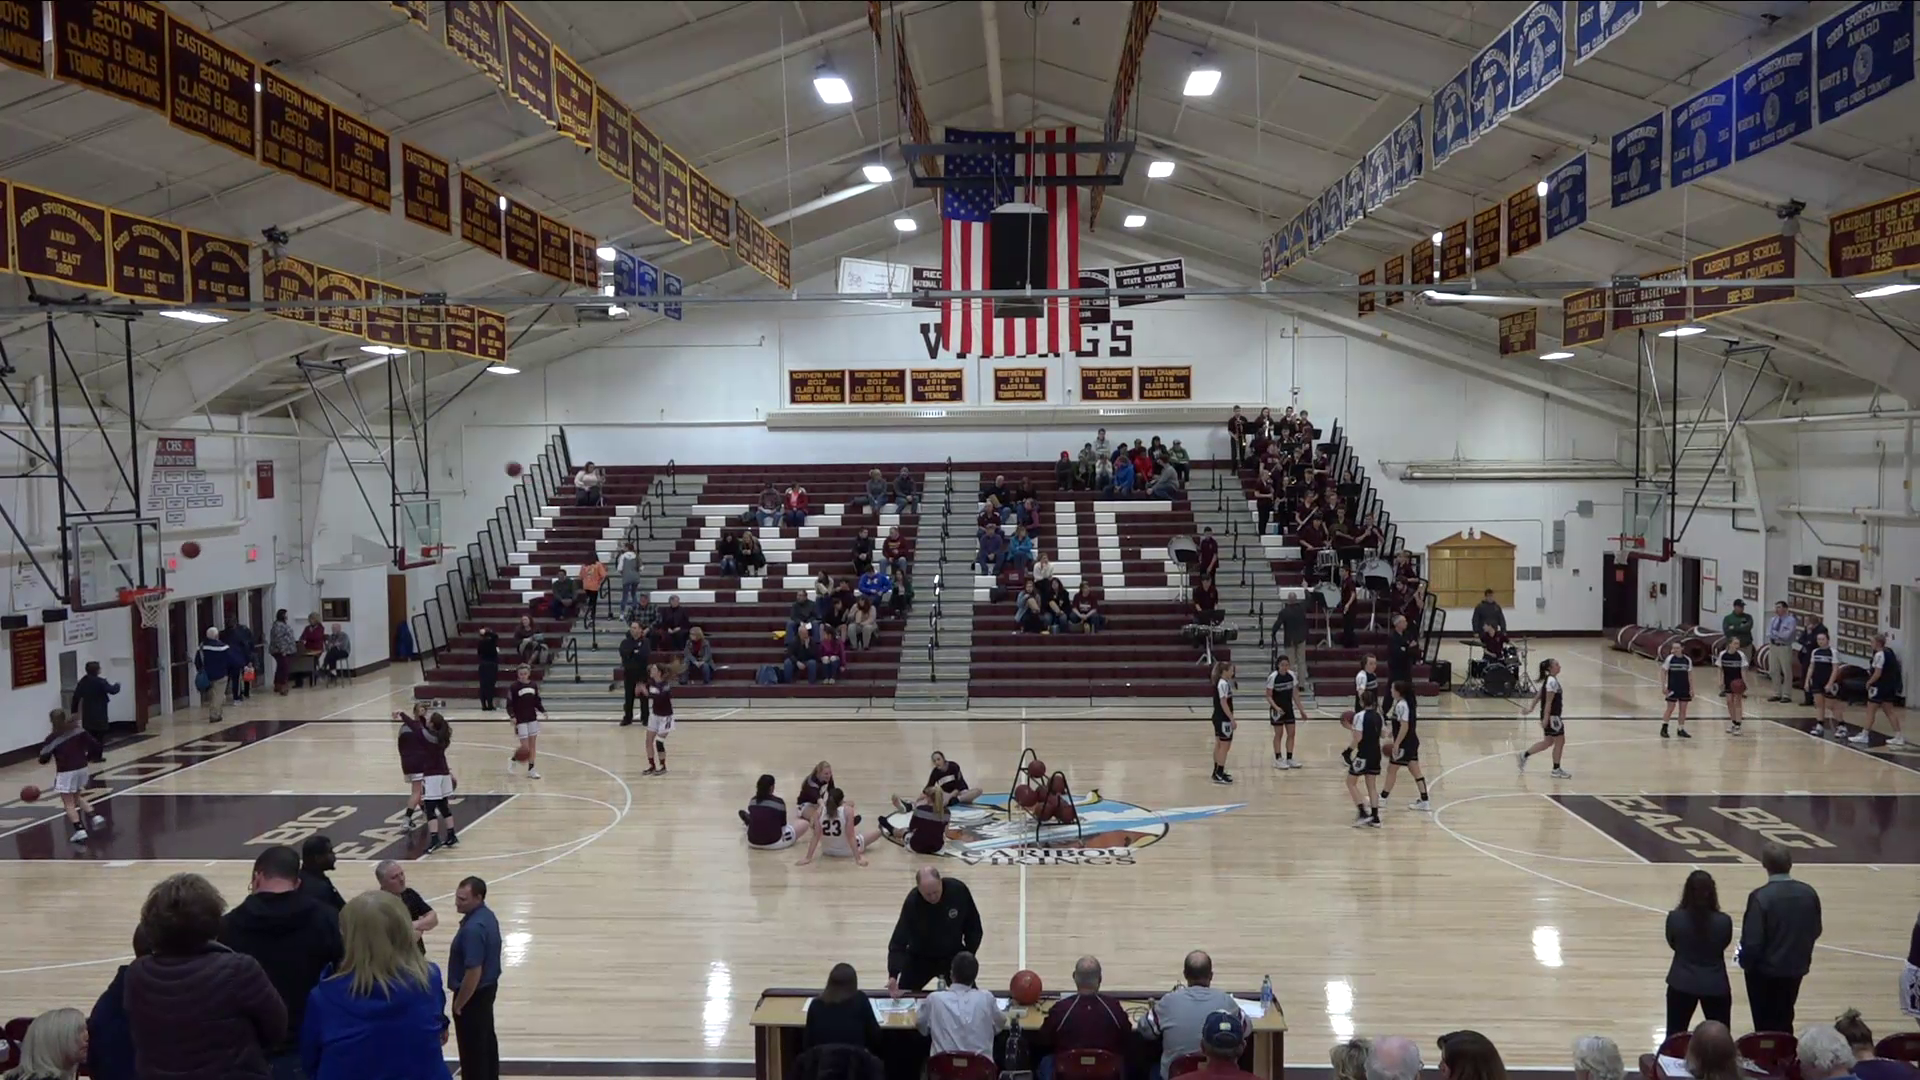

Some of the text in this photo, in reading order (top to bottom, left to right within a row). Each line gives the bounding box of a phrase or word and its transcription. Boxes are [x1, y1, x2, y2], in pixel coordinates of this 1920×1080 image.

[92, 9, 132, 39] 2010
[1580, 5, 1595, 27] EAST
[1844, 0, 1903, 34] SPORTSMANSHIP
[1847, 18, 1880, 48] AWARD
[67, 22, 157, 75] CLASS B GIRLS
[175, 29, 250, 82] EASTERN MAINE
[66, 48, 160, 102] TENNIS CHAMPIONS
[1757, 52, 1803, 81] SPORTSMANSHIP
[199, 66, 229, 92] 2010
[1760, 71, 1785, 95] AWARD
[179, 75, 248, 123] CLASS B GIRLS
[266, 77, 325, 120] EASTERN MAINE
[174, 97, 252, 148] SOCCER CHAMPIONS
[285, 108, 309, 130] 2010
[337, 116, 368, 142] EASTERN
[270, 120, 296, 146] CLASS
[341, 153, 363, 176] CLASS
[20, 202, 103, 243] GOOD SPORTSMANSHIP
[1834, 197, 1920, 235] CARIBOU HIGH SCH
[50, 229, 77, 246] AWARD
[1854, 215, 1914, 243] GIRLS STATE
[131, 225, 180, 262] SPORTSMANSHIP
[138, 245, 160, 260] AWARD
[1842, 242, 1872, 261] SOCCER
[45, 246, 82, 266] BIG EAST
[1703, 241, 1782, 275] CARIBOU HIGH SCHOOL
[1871, 251, 1893, 270] 1986
[139, 268, 157, 283] EAST
[211, 261, 230, 274] AWARD
[1116, 268, 1140, 278] CARIBOU
[1160, 262, 1181, 272] SCHOOL
[1122, 272, 1176, 285] STATE CHAMPIONS
[1745, 259, 1785, 280] CHAMPIONS
[210, 282, 226, 296] EAST
[1640, 287, 1681, 301] BASKETBALL
[792, 372, 823, 380] NORTHERN
[929, 371, 961, 380] CHAMPIONS
[1157, 369, 1189, 377] CHAMPIONS
[795, 386, 815, 394] CLASS
[822, 386, 841, 394] GIRLS
[813, 394, 842, 402] CHAMPIONS
[855, 386, 875, 394] CLASS
[882, 386, 900, 394] GIRLS
[925, 392, 950, 400] TENNIS
[1096, 390, 1119, 398] TRACK
[243, 805, 358, 847] BIG
[822, 820, 842, 837] 23
[1592, 794, 1762, 864] EAST
[1708, 806, 1837, 850] BIG
[960, 857, 1137, 867] VIKINGS
[961, 848, 1133, 859] CARIBOU
